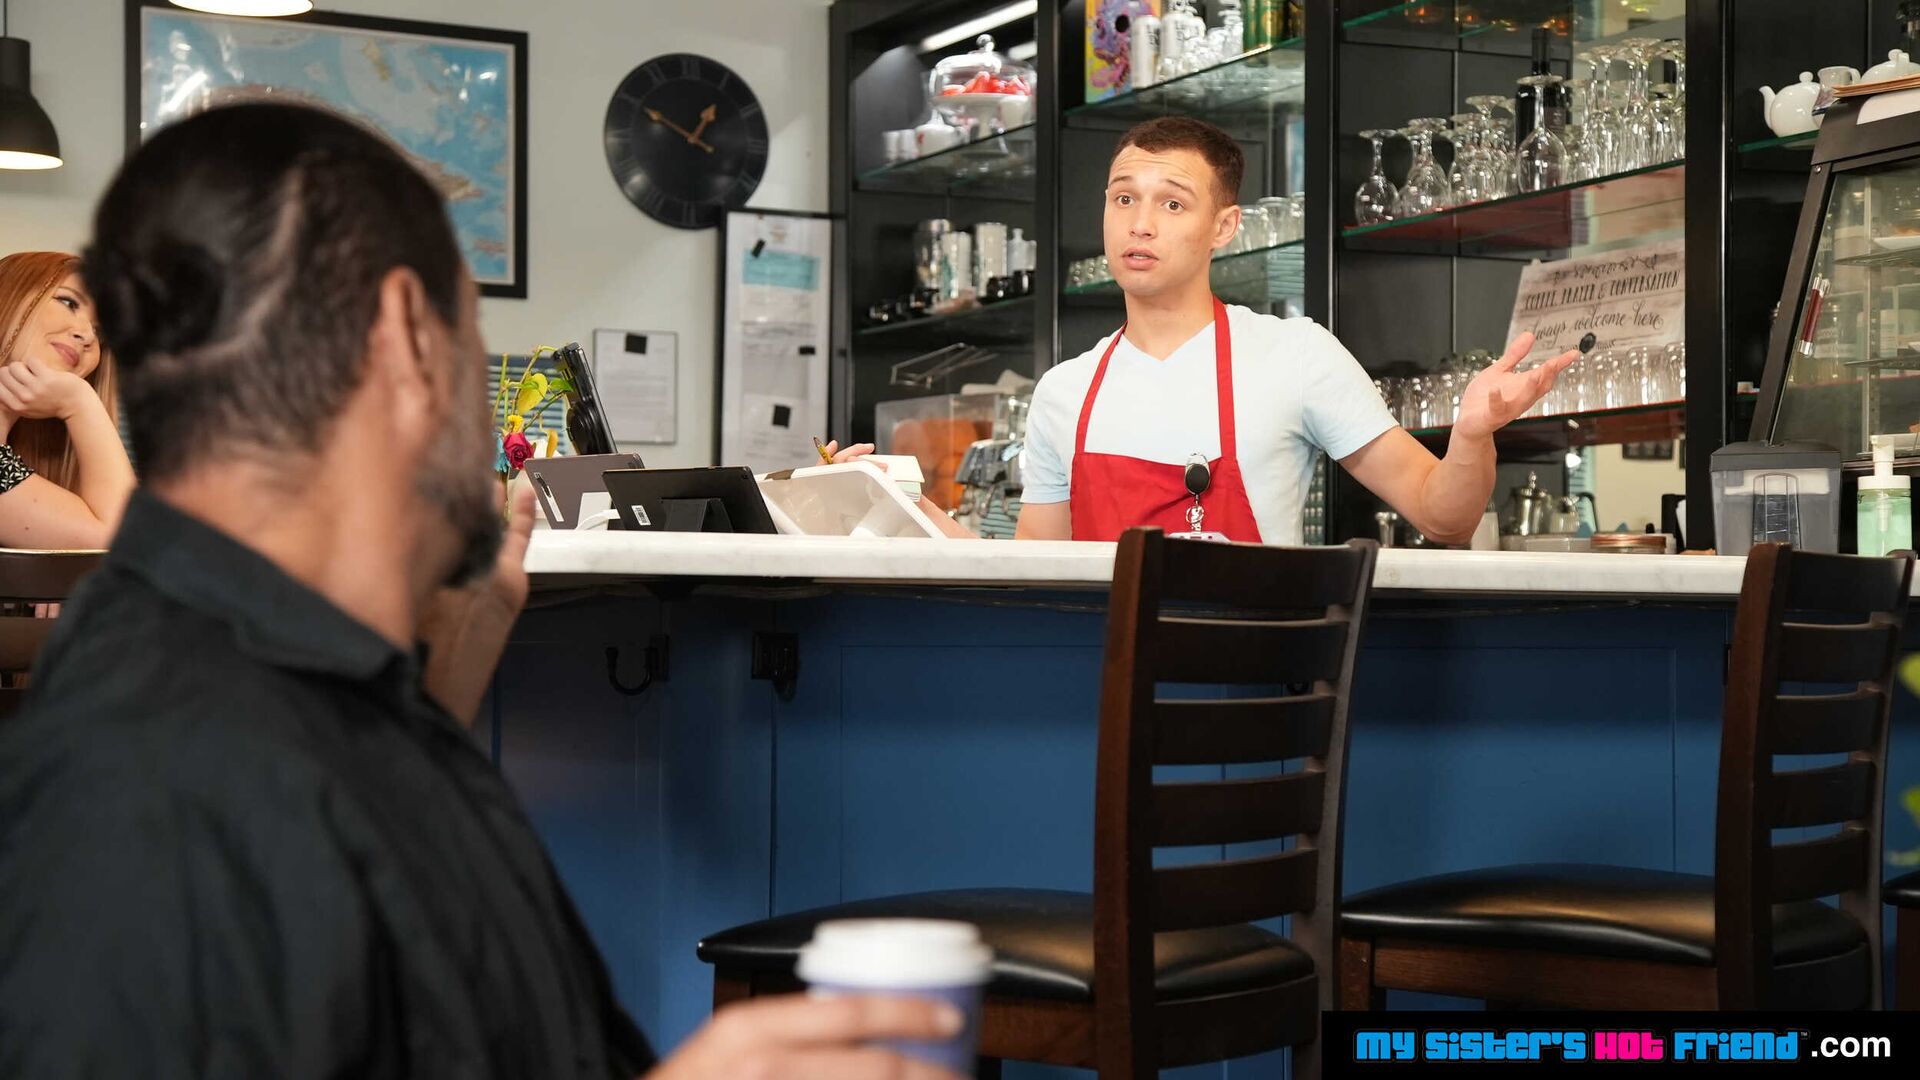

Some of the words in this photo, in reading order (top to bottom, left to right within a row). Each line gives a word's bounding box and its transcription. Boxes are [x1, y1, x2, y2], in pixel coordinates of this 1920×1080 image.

[1609, 269, 1681, 297] CONVERSATION
[1531, 318, 1567, 346] lways
[1574, 305, 1627, 332] welcome
[1632, 300, 1664, 329] here
